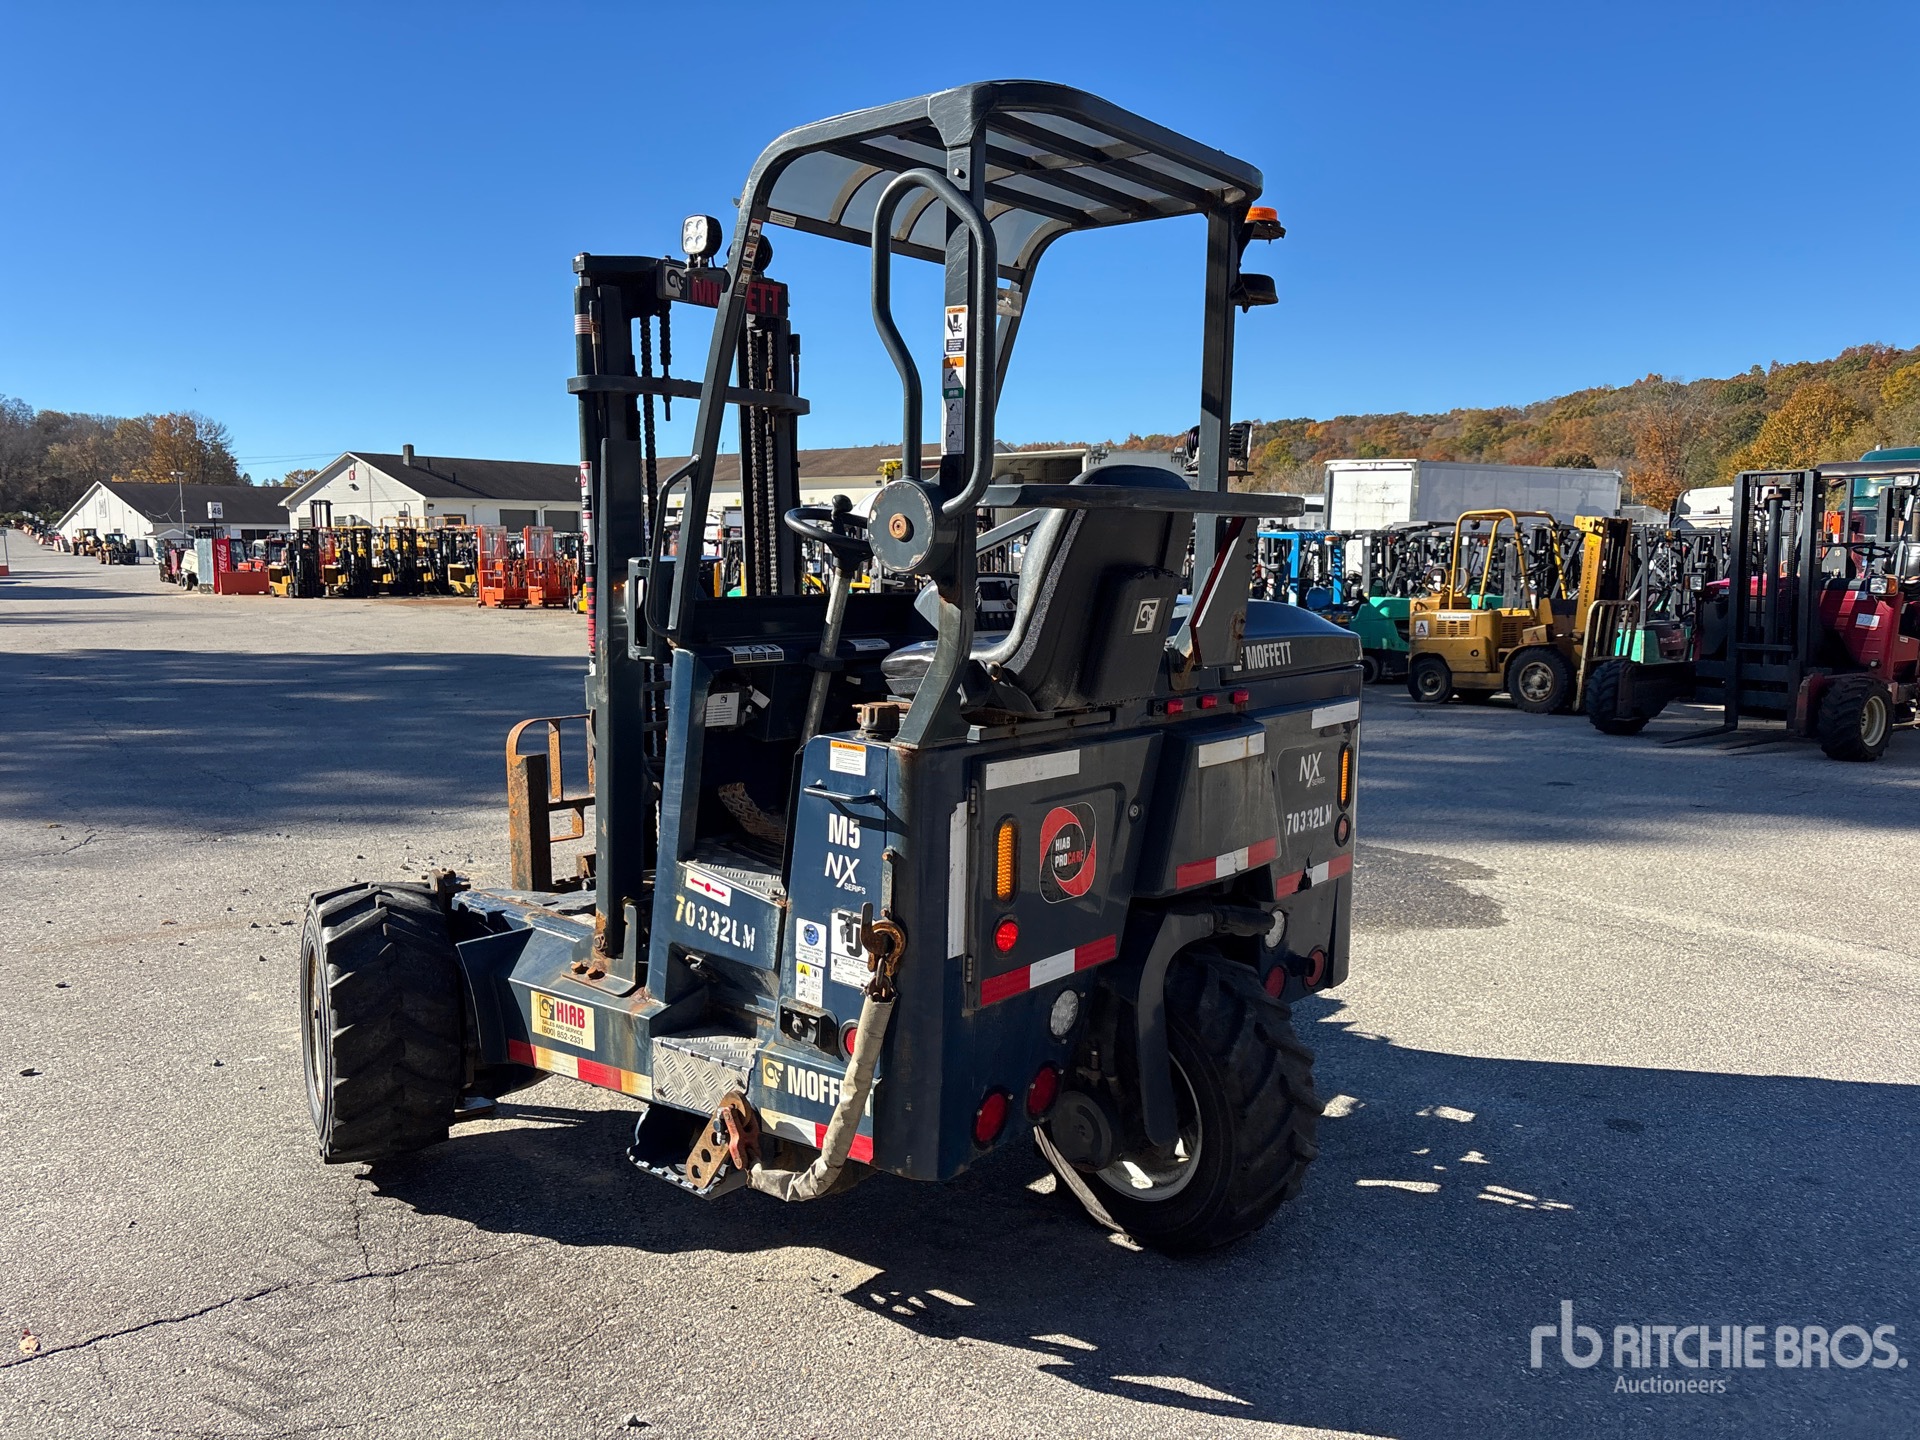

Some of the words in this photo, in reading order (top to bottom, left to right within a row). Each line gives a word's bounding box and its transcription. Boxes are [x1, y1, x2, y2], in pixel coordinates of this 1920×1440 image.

[212, 507, 222, 515] 48
[1246, 641, 1292, 670] MOFFETT
[1299, 751, 1322, 788] NX
[1311, 776, 1326, 787] SERIES
[828, 813, 861, 849] M5
[1286, 803, 1333, 836] 70332LM
[1055, 836, 1071, 851] HIAB
[824, 852, 860, 888] NX
[843, 882, 867, 895] SERIES
[675, 894, 756, 951] 70332LM
[542, 1019, 555, 1028] SALES
[565, 1026, 584, 1037] SERVICE
[556, 1001, 585, 1029] HIAB
[557, 1030, 584, 1046] 852-2331
